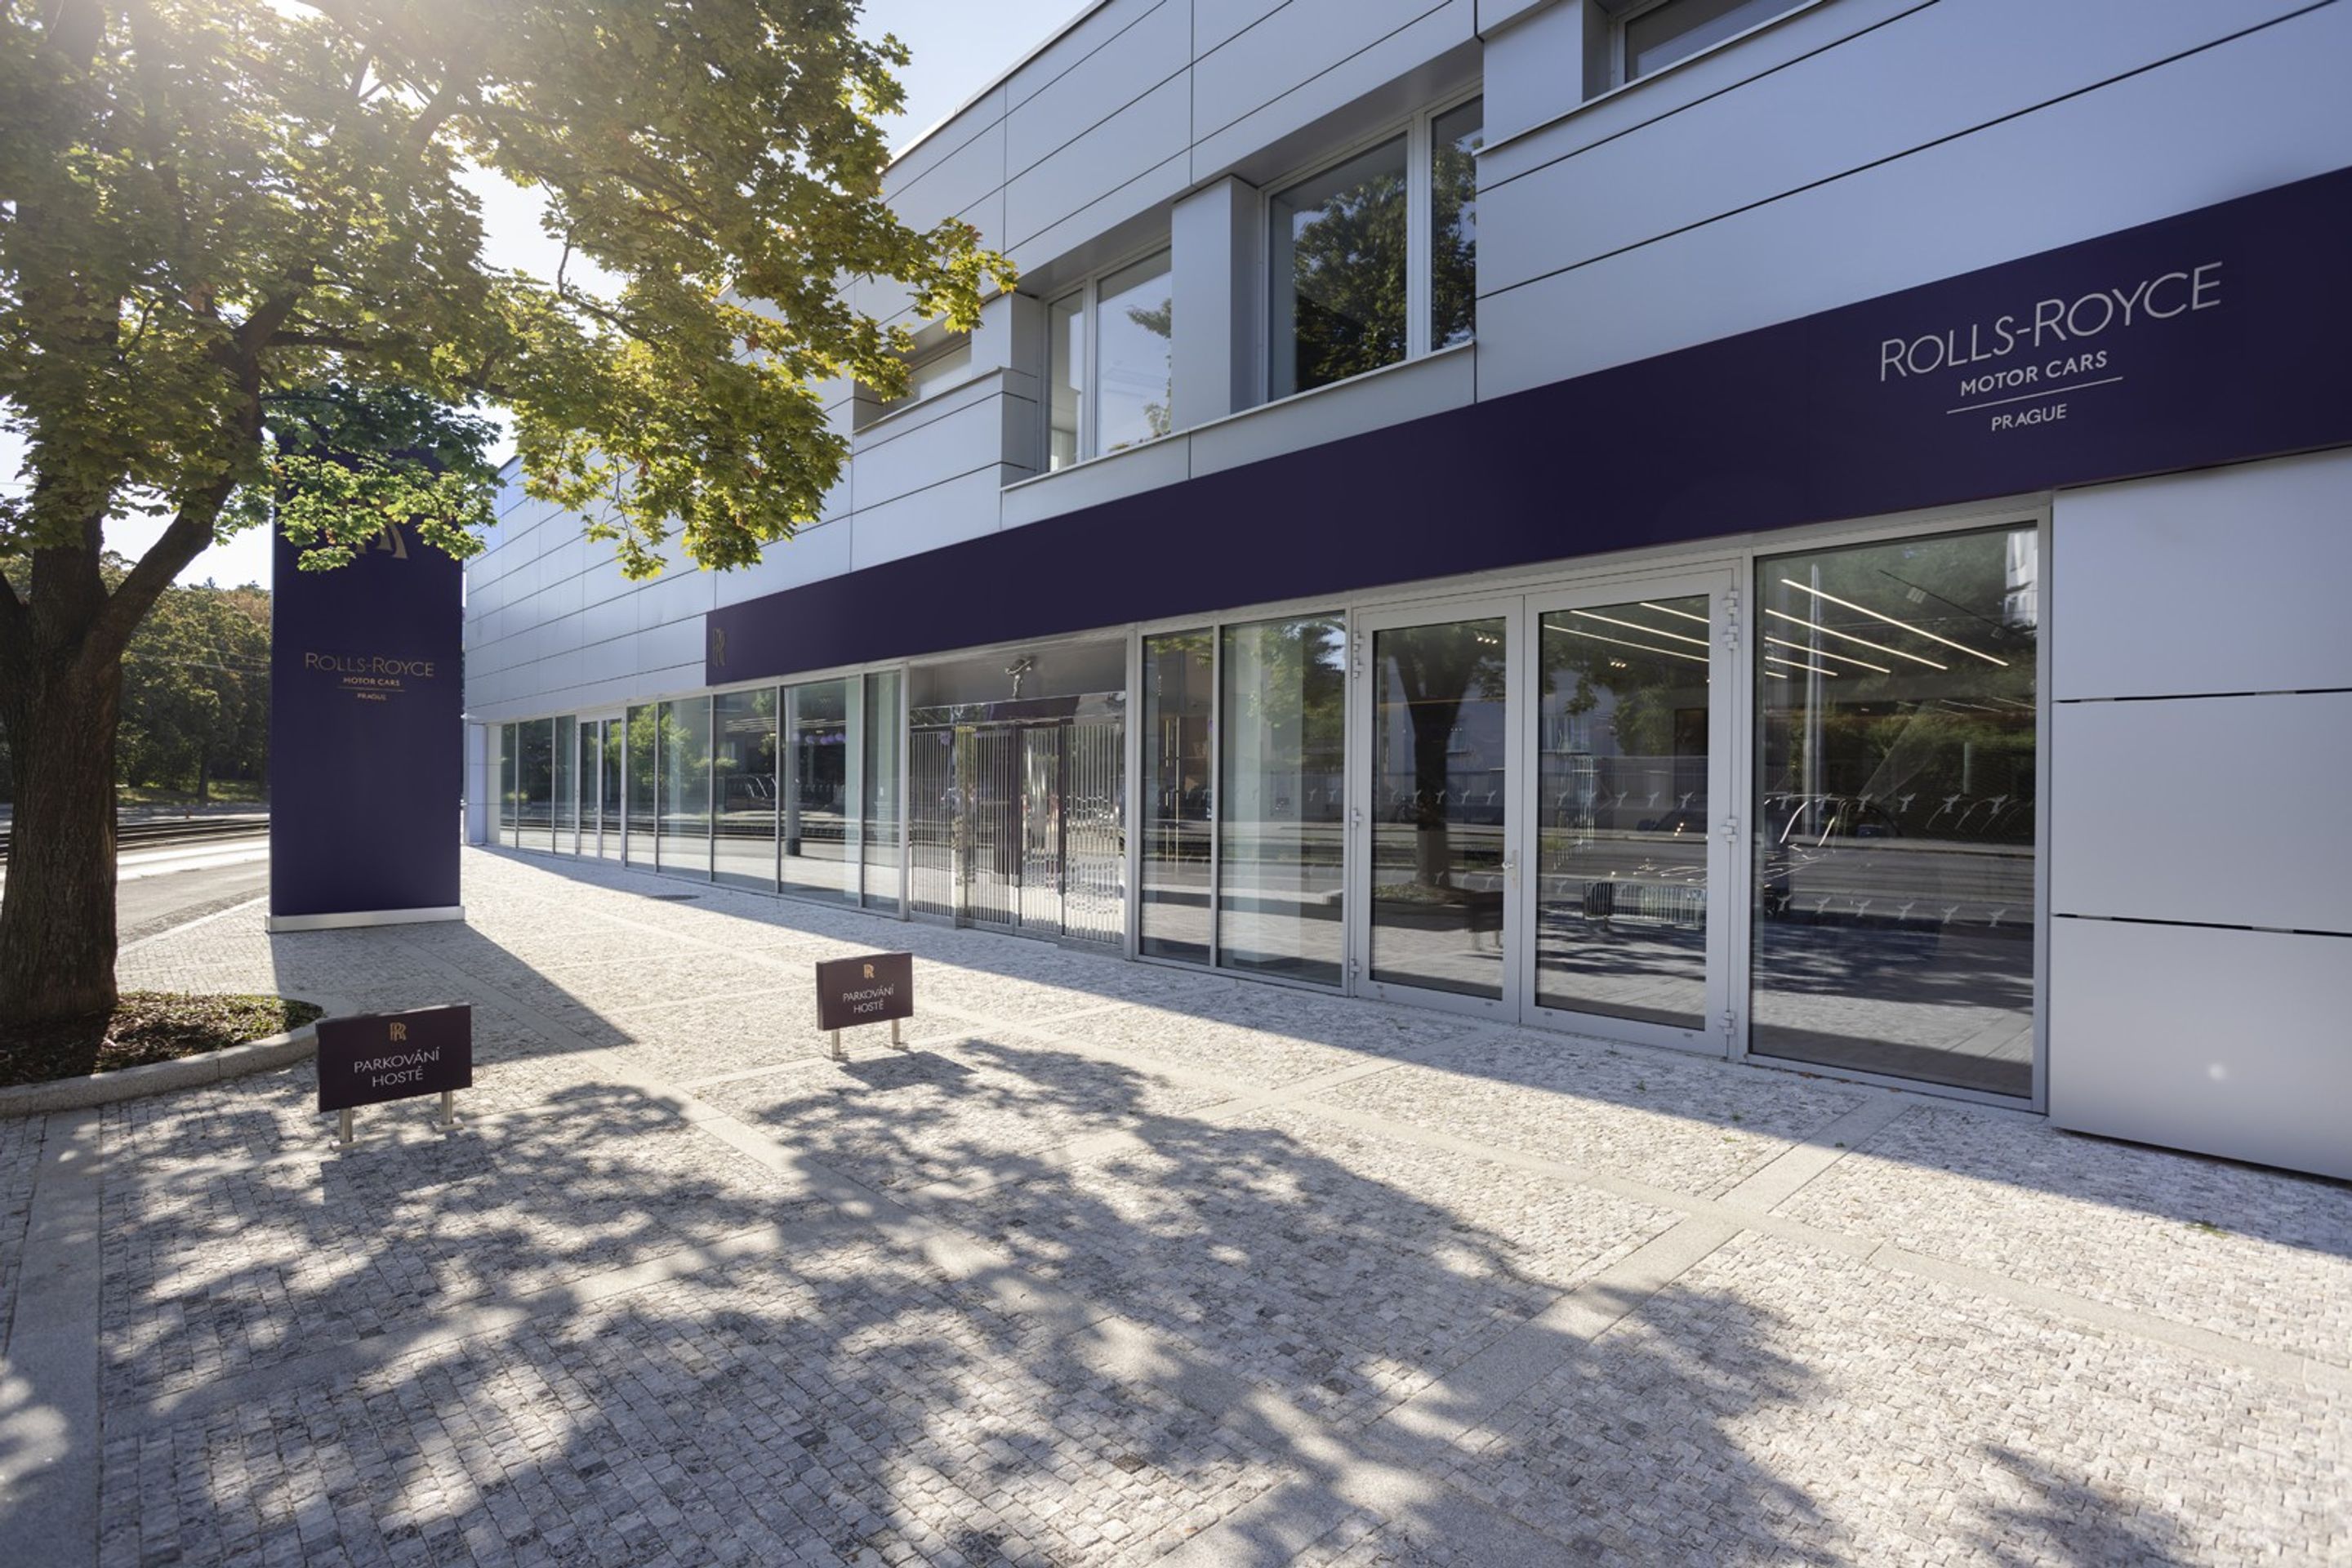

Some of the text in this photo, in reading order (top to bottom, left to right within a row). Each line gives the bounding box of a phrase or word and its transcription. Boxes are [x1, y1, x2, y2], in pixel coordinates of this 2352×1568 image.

[1880, 261, 2223, 381] ROLLS-ROYCE
[1959, 350, 2109, 397] MOTOR CARS
[1990, 403, 2068, 432] PRAGUE
[305, 653, 434, 676] ROLLS-ROYCE
[343, 677, 400, 687] MOTOR CARS
[843, 983, 894, 1003] PARKOVÁNÍ
[354, 1046, 440, 1074] PARKOVÁNÍ
[372, 1066, 424, 1088] HOSTÉ
